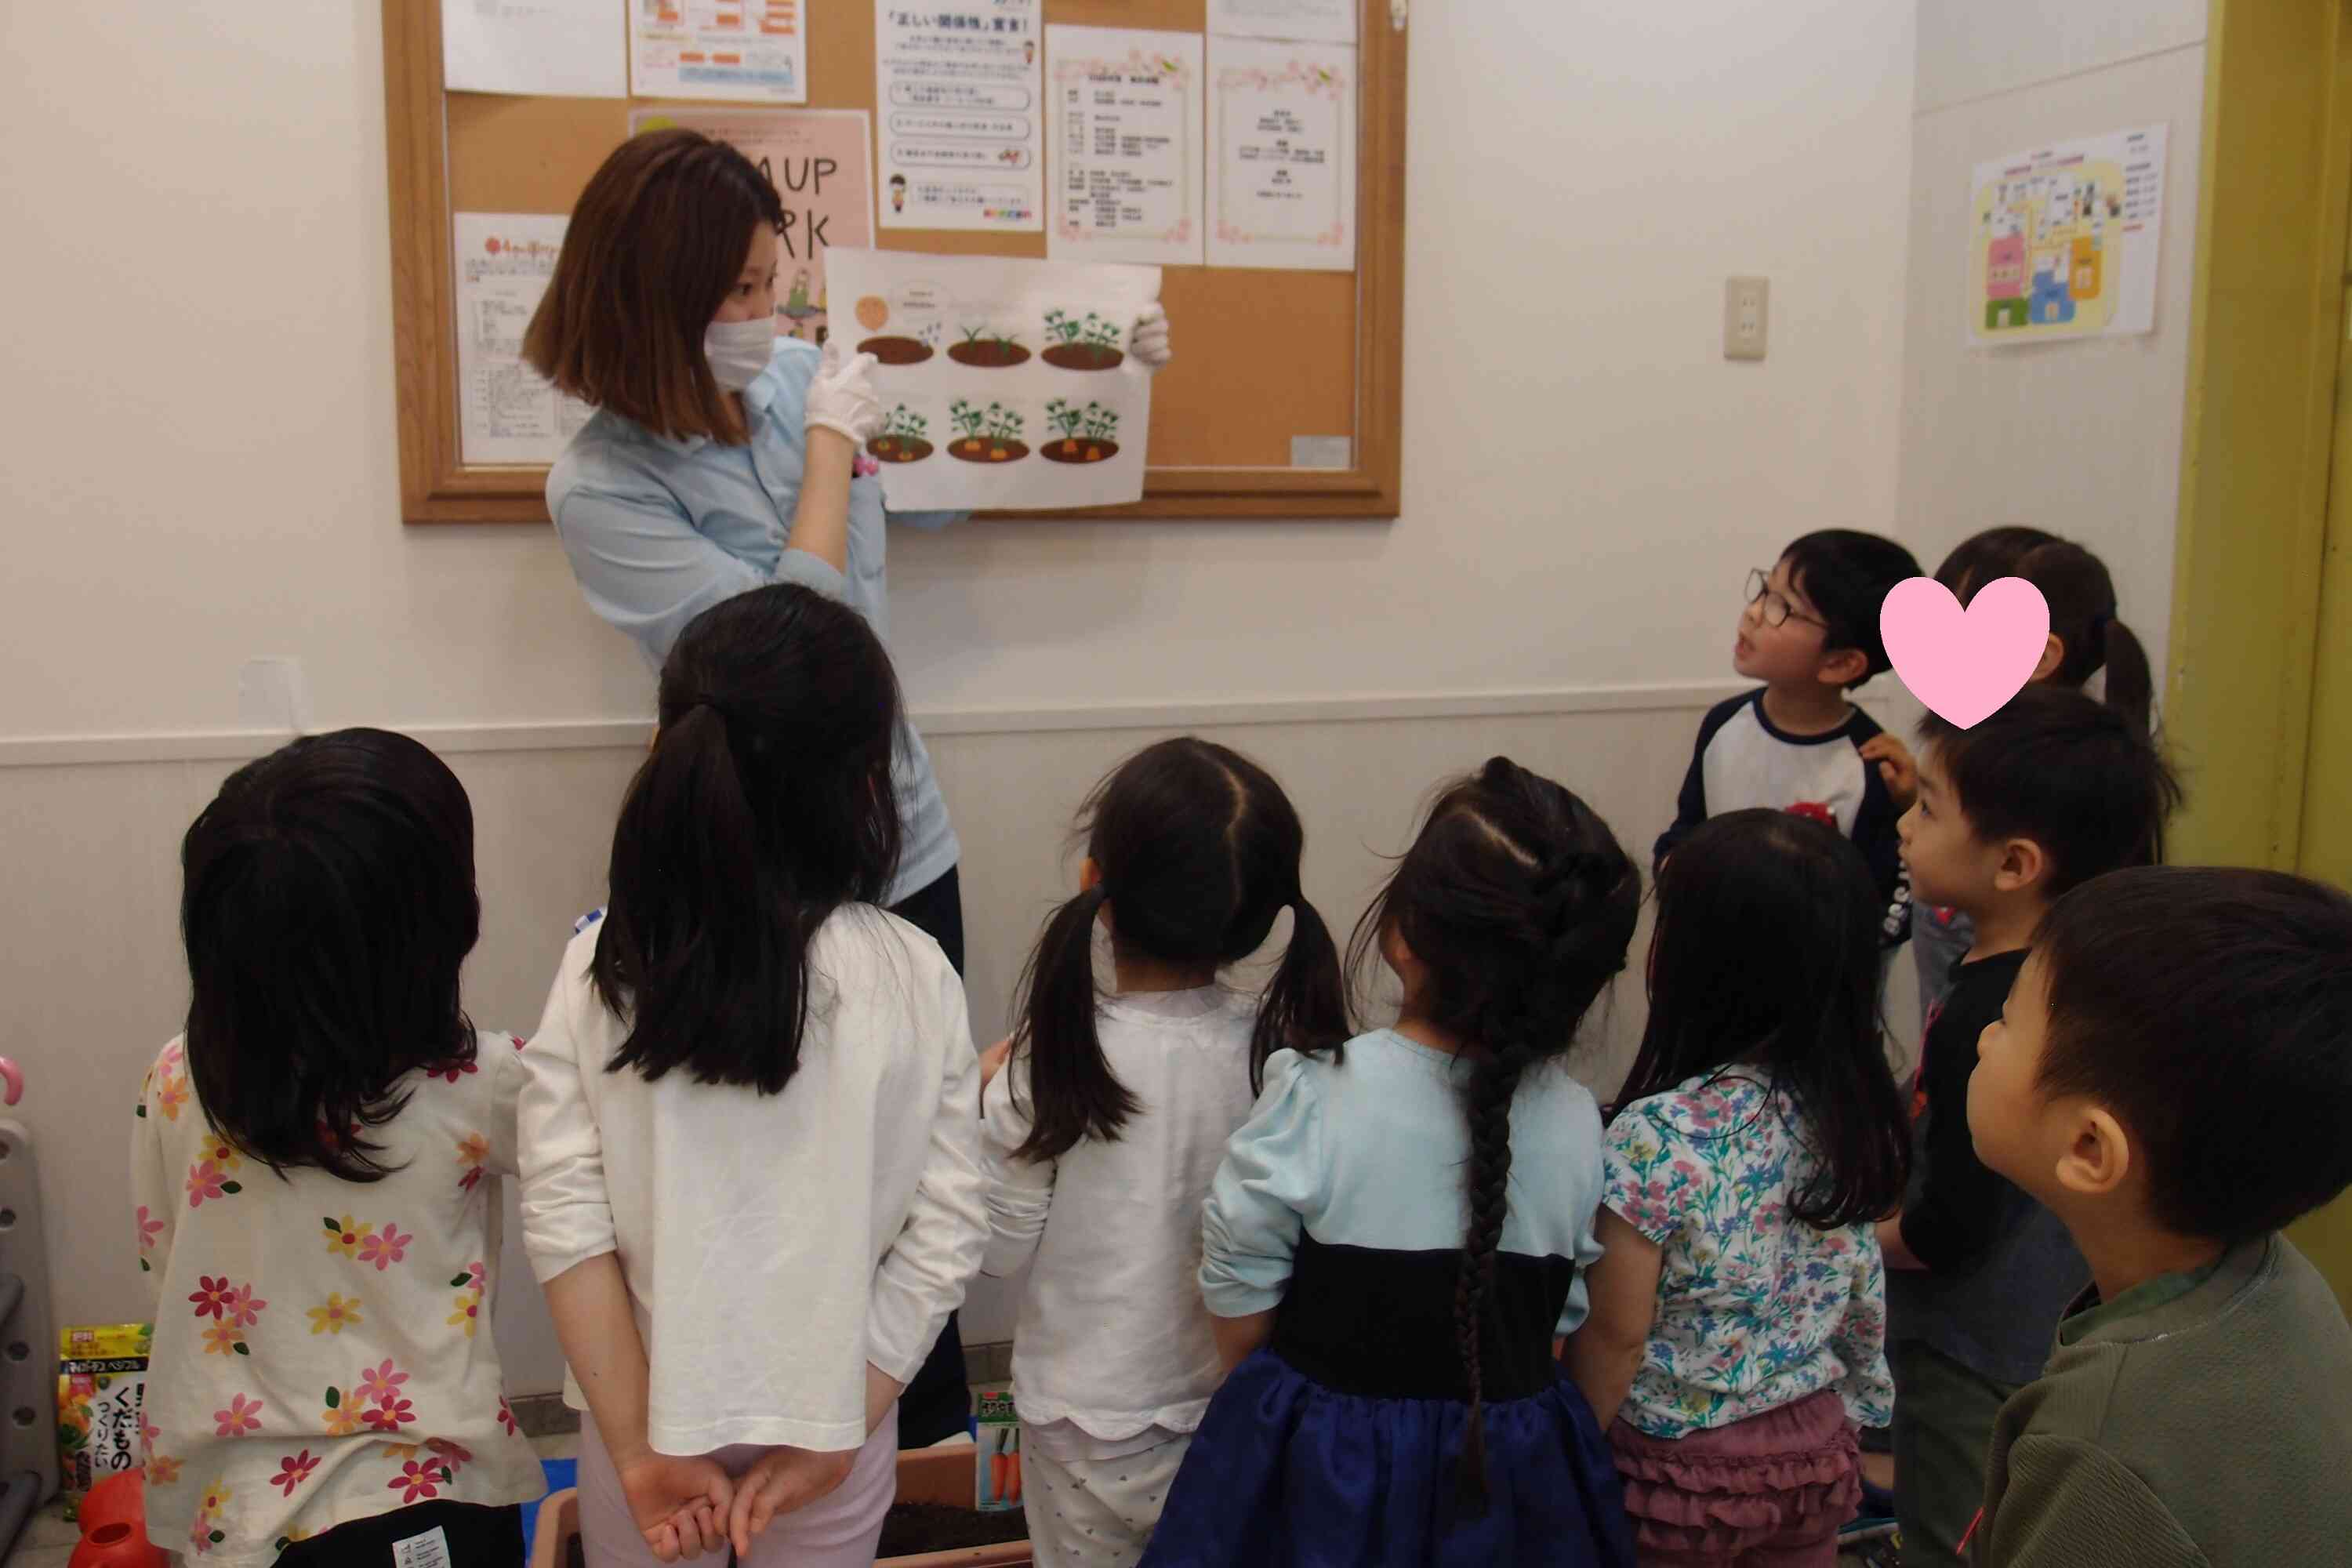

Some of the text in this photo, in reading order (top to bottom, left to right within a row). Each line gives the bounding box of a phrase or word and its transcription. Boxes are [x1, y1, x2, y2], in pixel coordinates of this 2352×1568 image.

[94, 1401, 111, 1468] つくりたい
[111, 1386, 132, 1470] くだもの
